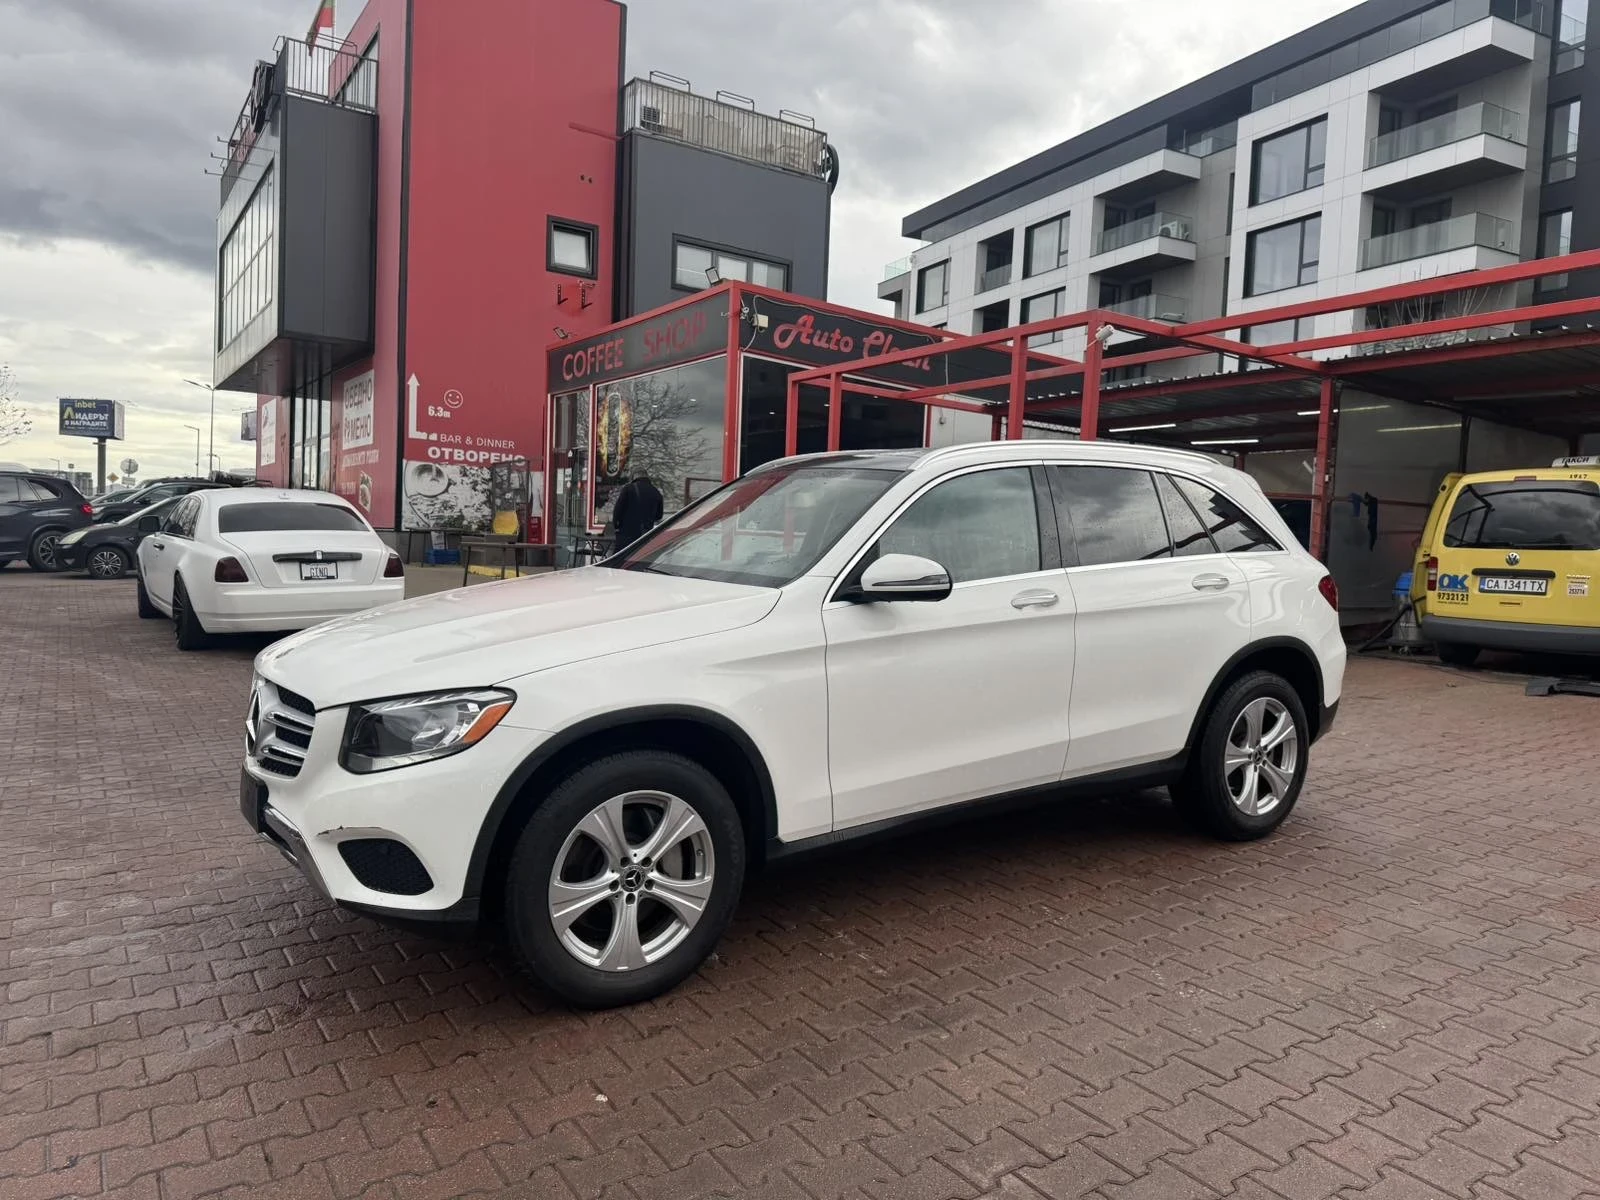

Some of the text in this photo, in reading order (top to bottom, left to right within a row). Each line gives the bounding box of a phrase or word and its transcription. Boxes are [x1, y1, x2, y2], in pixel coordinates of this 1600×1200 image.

[774, 314, 855, 353] Auto
[562, 311, 707, 382] COFFEE SHOP
[344, 377, 373, 410] ОБЕДНО
[74, 400, 96, 409] inbet
[427, 405, 451, 418] 6.3m
[350, 413, 371, 442] МЕНЮ
[440, 433, 515, 449] BAR & DINNER
[427, 446, 526, 466] ОТВОРЕНО
[1439, 573, 1469, 589] OK
[1504, 580, 1526, 590] 1341
[1530, 581, 1544, 592] TX
[1437, 592, 1469, 602] 9732121
